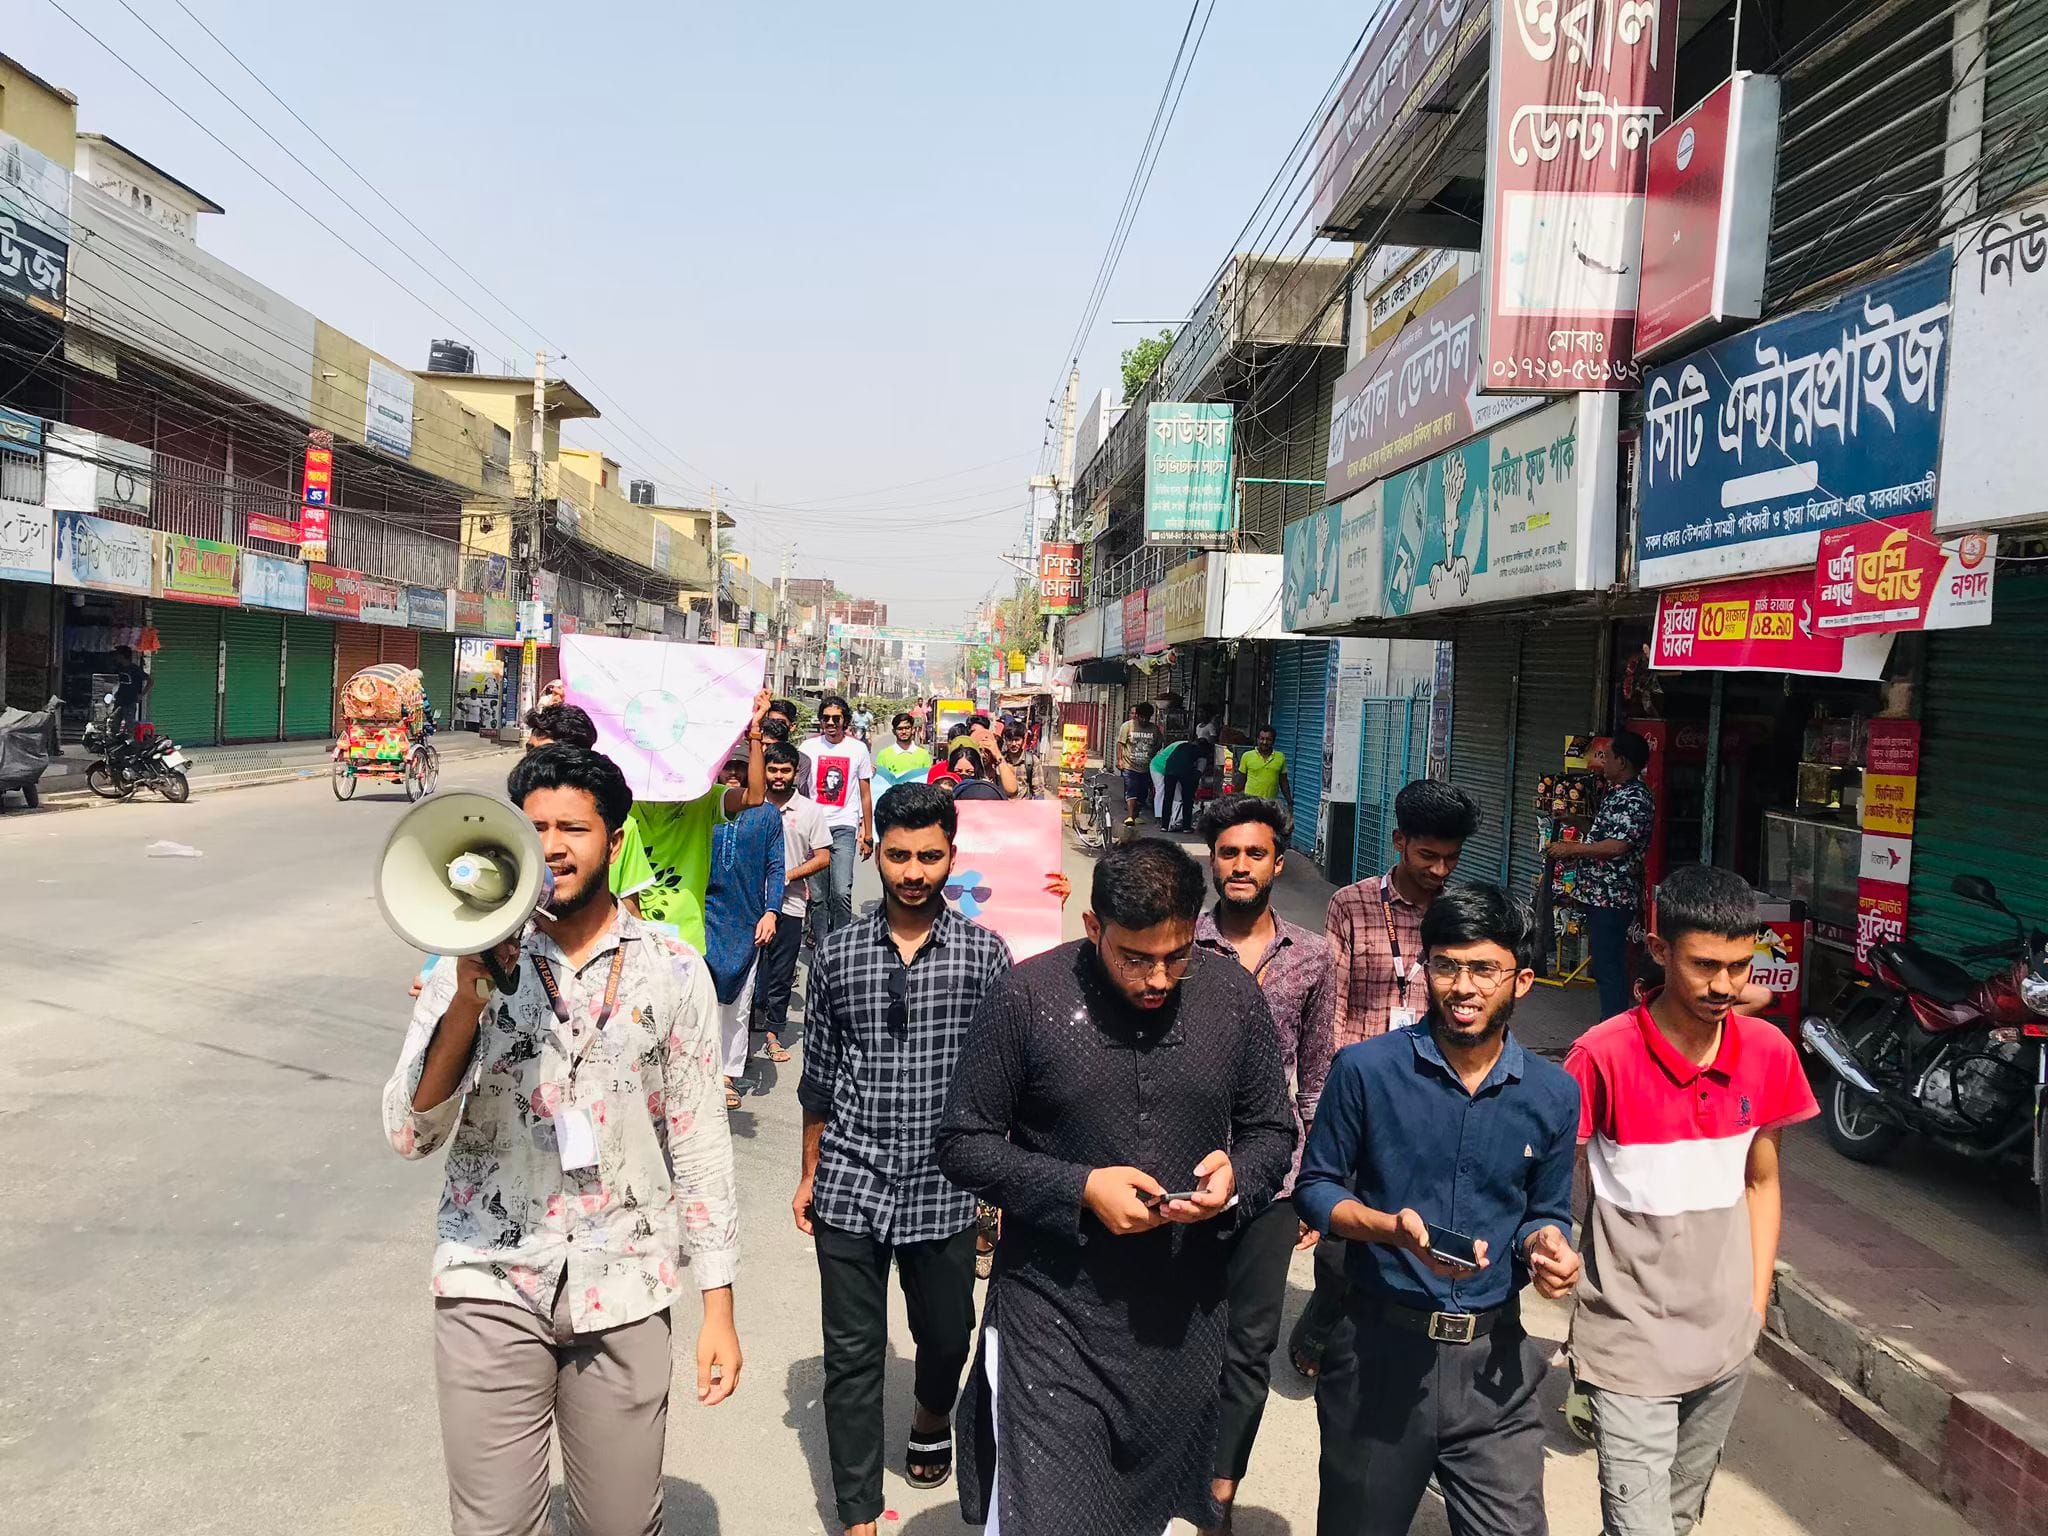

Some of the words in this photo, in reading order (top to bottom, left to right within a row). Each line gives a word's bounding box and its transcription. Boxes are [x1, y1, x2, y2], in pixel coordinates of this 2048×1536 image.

[1513, 0, 1661, 74] ওরাল
[1509, 80, 1665, 172] ডেন্টাল
[1976, 212, 2048, 296] নিউ
[1548, 328, 1604, 353] মোবাঃ
[1348, 369, 1394, 442] ওরাল
[1397, 313, 1476, 419] ডেন্টাল
[1646, 364, 1710, 488] সিটি
[1718, 294, 1953, 466] এন্টারপ্রাইজ
[1153, 453, 1200, 477] ডিজিটাল
[1491, 446, 1523, 515] কুষ্টিয়া
[1525, 446, 1547, 504] ফুড
[1549, 416, 1577, 484] পার্ক
[1662, 530, 1681, 549] প্রকার
[1738, 505, 1770, 534] পাইকারী
[1773, 511, 1780, 528] ও
[1782, 506, 1804, 531] খুচরা
[1806, 497, 1843, 523] বিক্রেতা
[1845, 494, 1866, 515] এবং
[1869, 471, 1937, 510] সরবরাহকারী
[1042, 552, 1081, 577] শিশু
[1856, 528, 1910, 594] বেশি
[1041, 578, 1081, 599] মেলা
[1876, 568, 1924, 601] লাভ
[1951, 572, 1990, 600] নগদ
[1663, 601, 1697, 636] সুবিধা
[1702, 607, 1725, 637] ৫০
[1754, 615, 1793, 637] ১৪.৯০
[1662, 634, 1694, 657] ডাবল
[542, 969, 560, 1000] EARTH
[606, 974, 617, 1006] RENEW
[613, 944, 625, 973] EARTH
